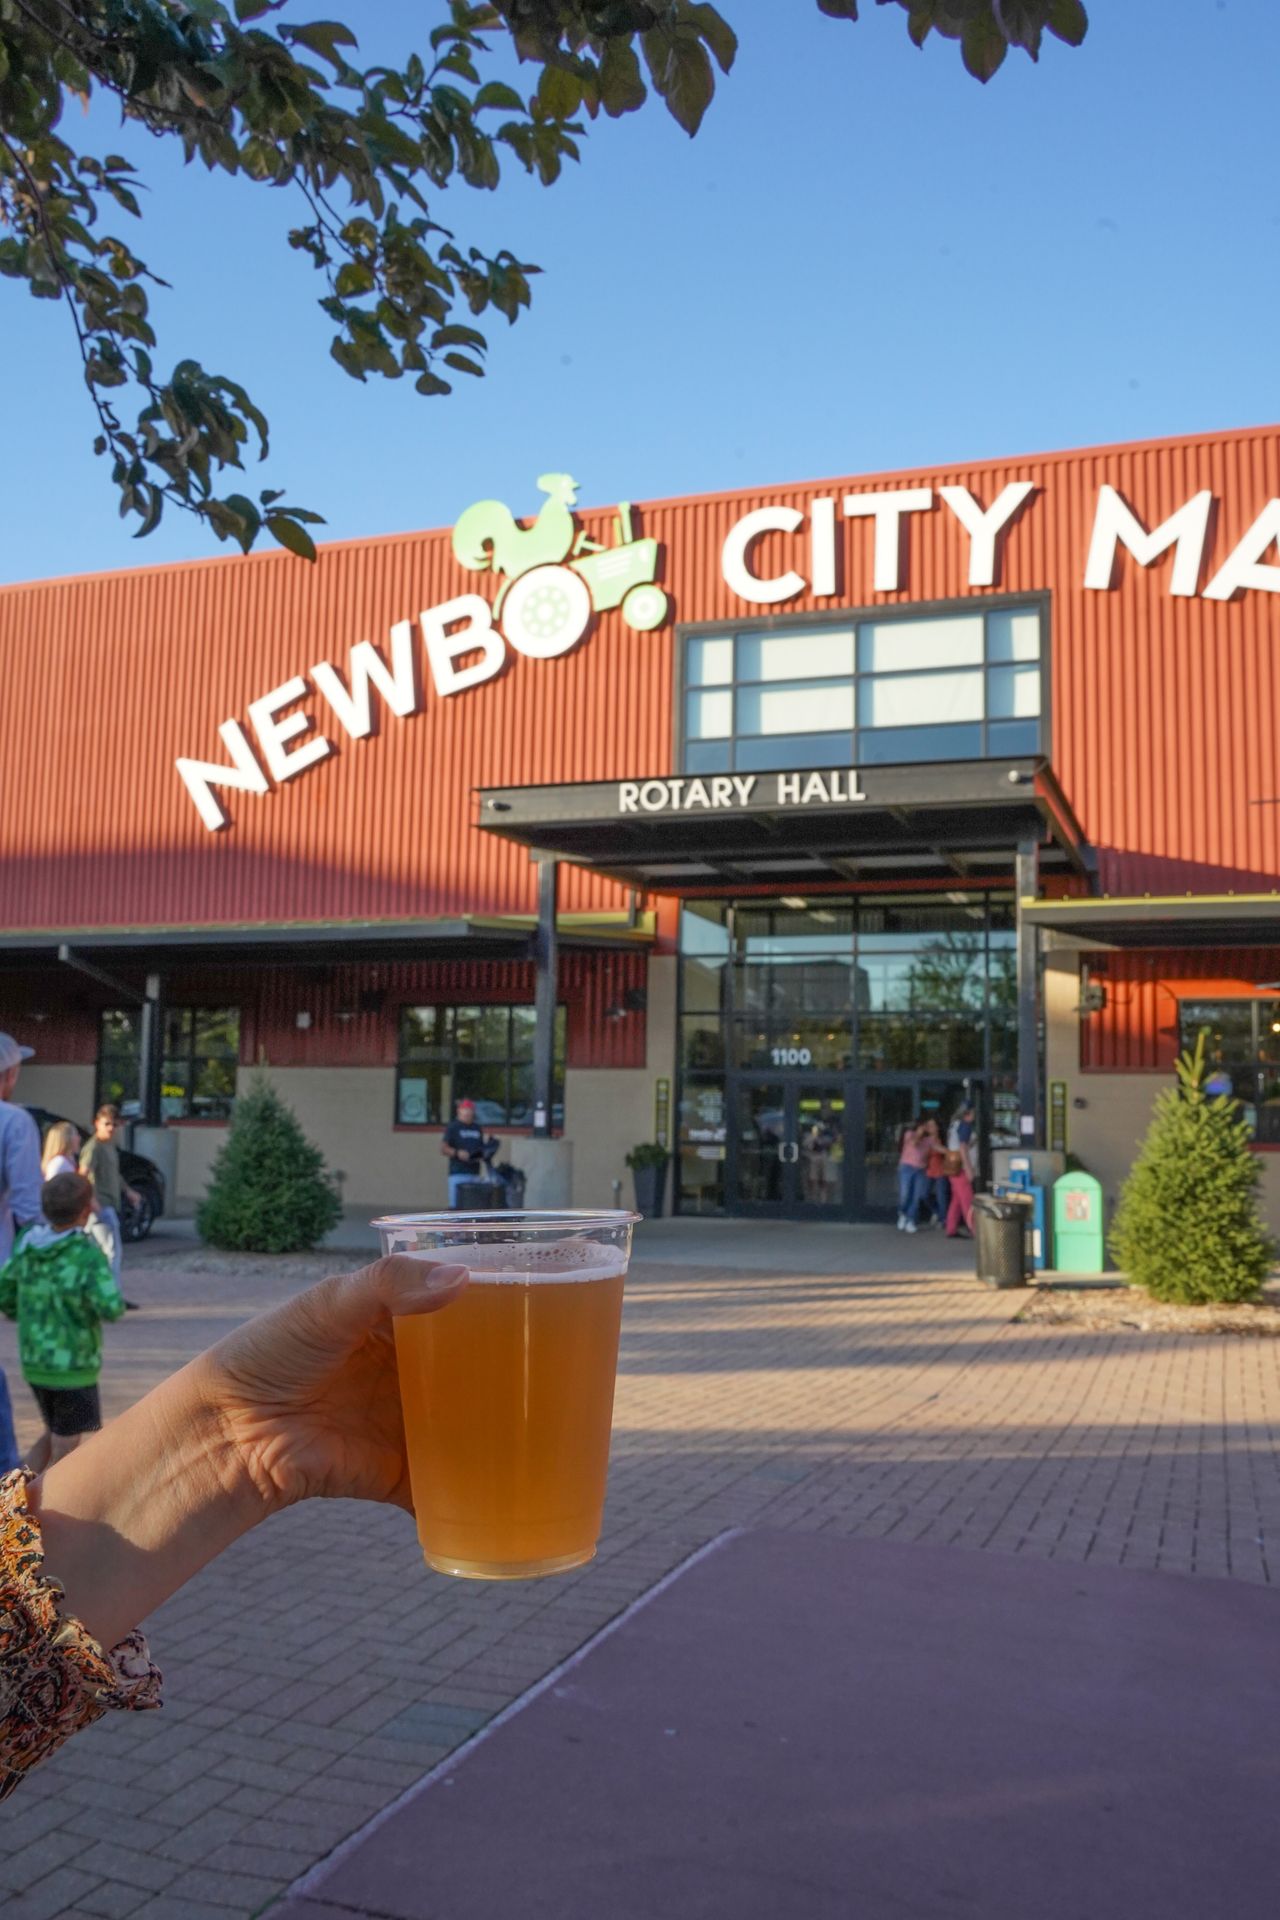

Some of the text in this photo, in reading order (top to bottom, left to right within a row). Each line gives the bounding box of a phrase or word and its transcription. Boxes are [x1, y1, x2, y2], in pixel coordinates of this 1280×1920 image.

[721, 481, 1035, 604] CITY
[618, 769, 867, 813] ROTARY HALL
[771, 1048, 811, 1065] 1100
